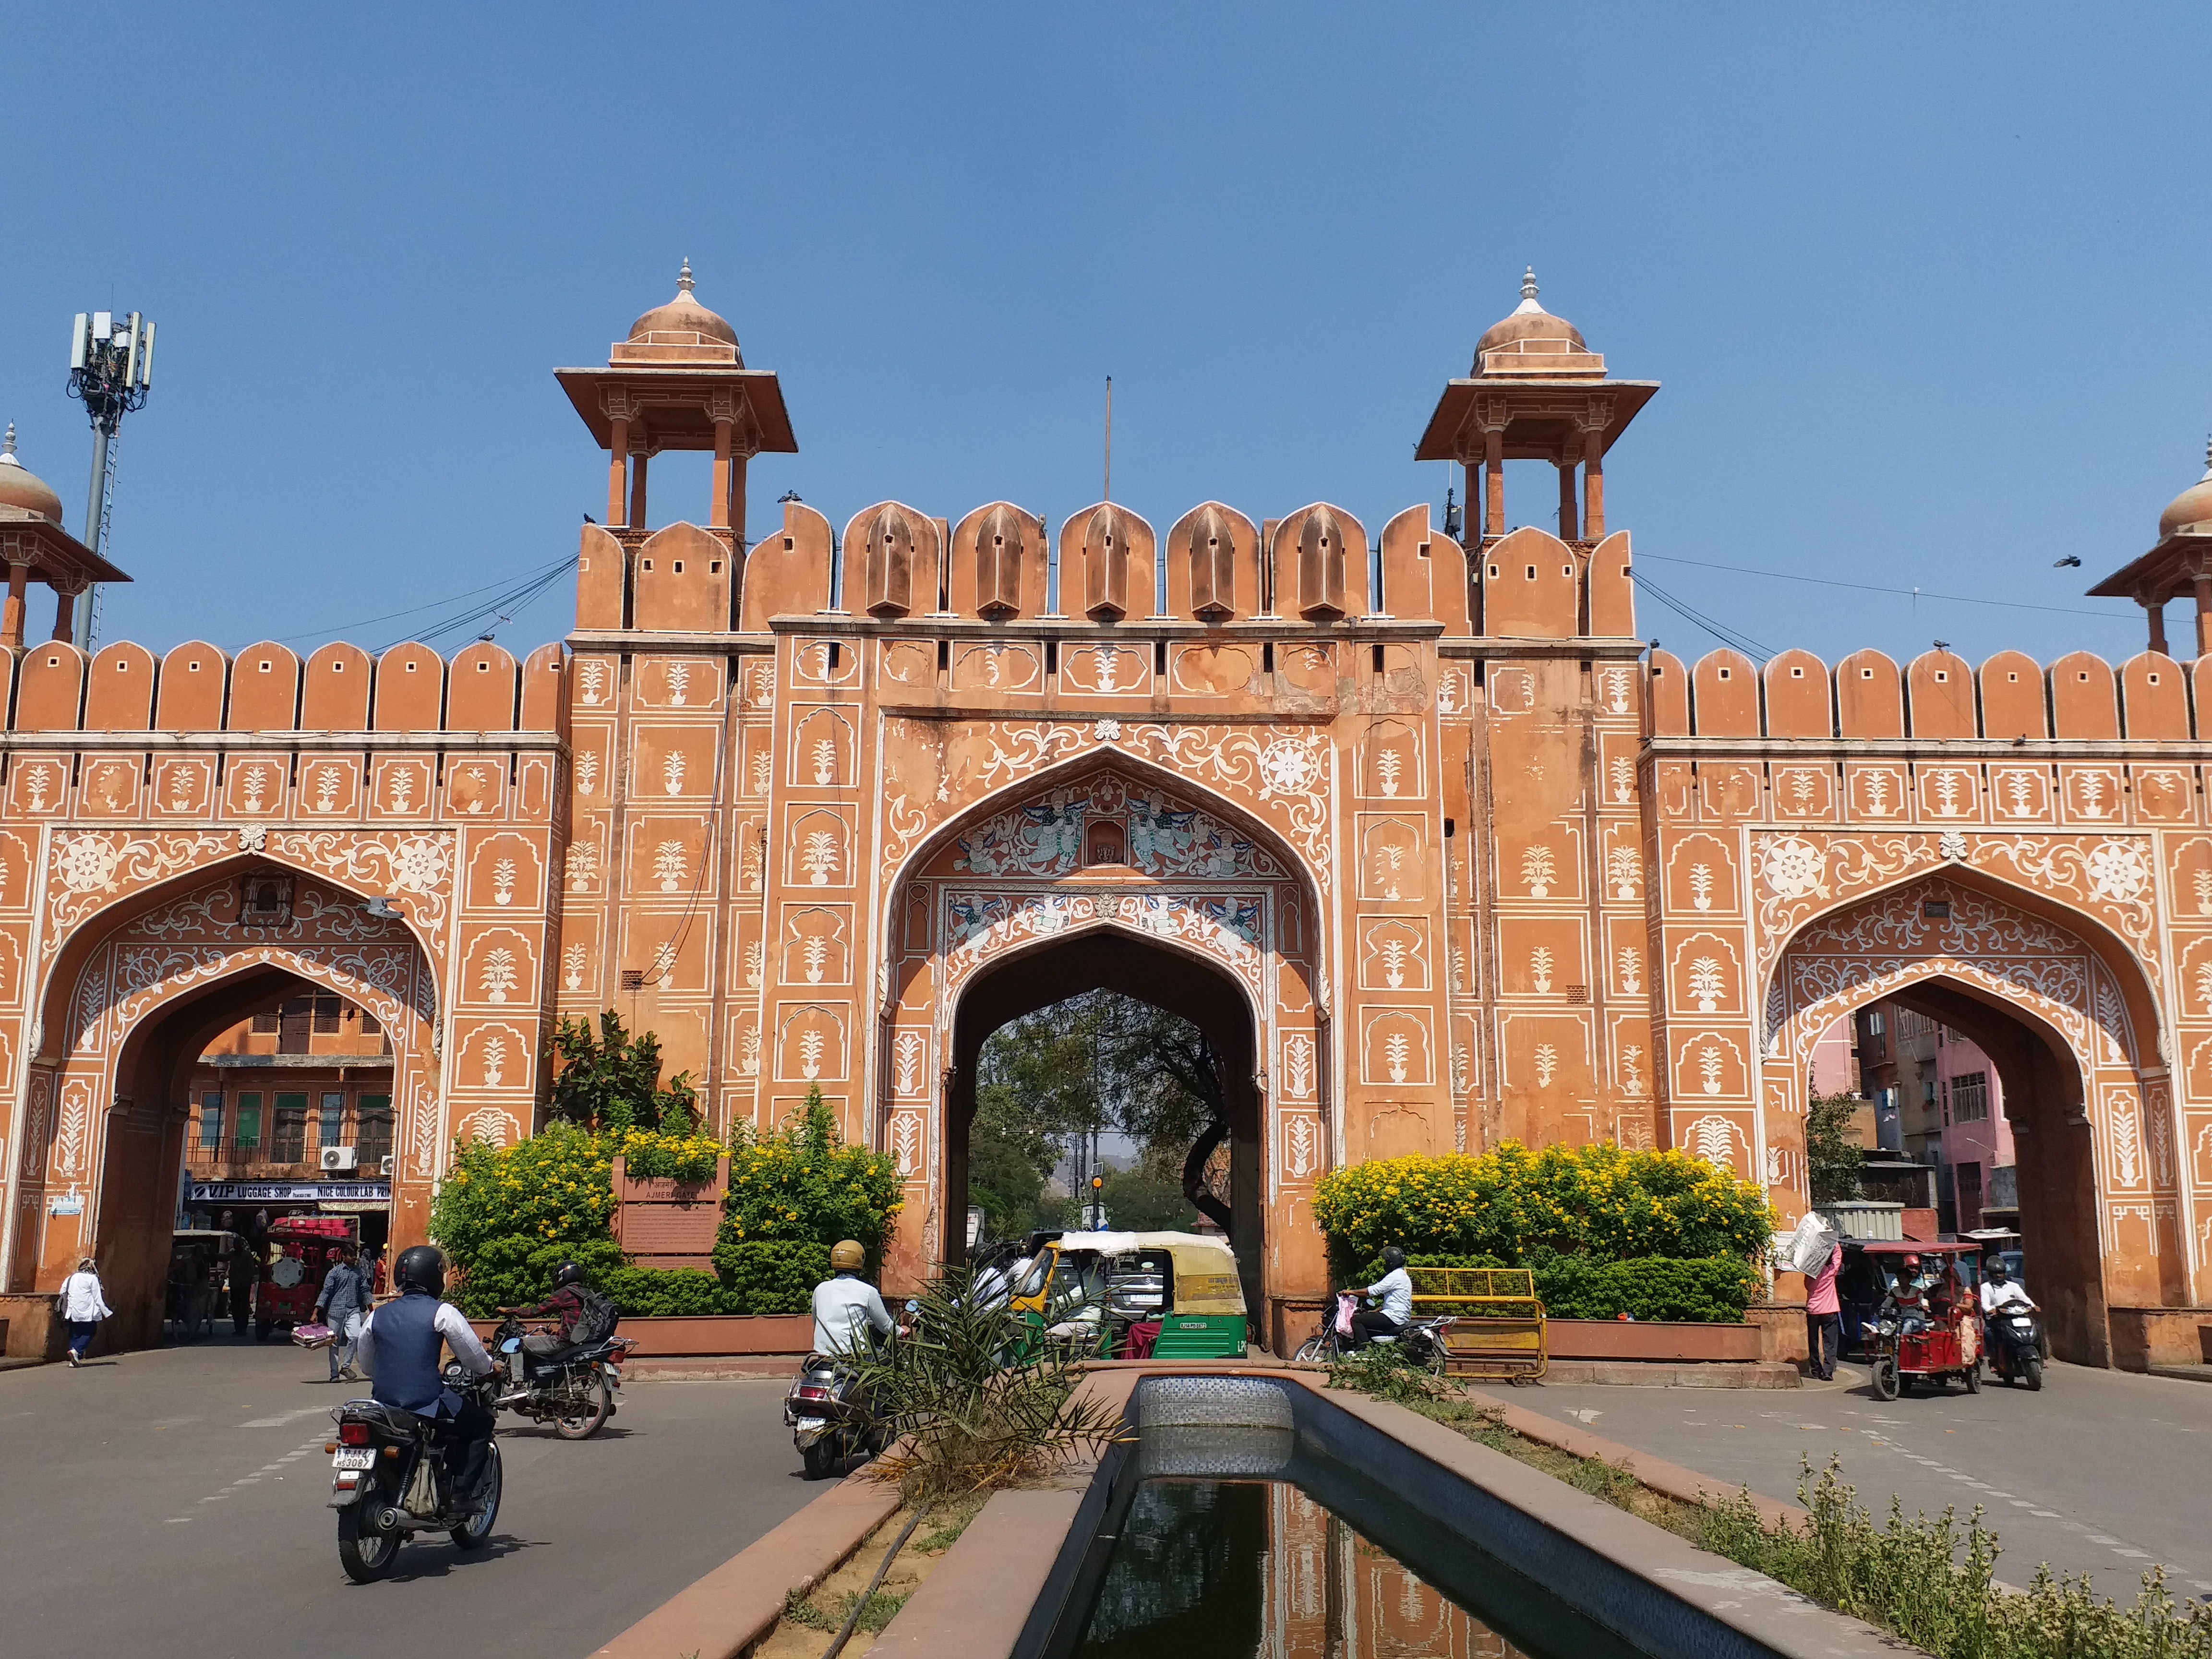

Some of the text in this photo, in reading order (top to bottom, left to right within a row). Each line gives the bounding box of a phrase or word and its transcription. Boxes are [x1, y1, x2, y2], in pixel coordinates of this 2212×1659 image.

[237, 1187, 271, 1198] LUGGAGE
[274, 1187, 291, 1198] SHOP
[317, 1186, 334, 1197] NICE
[336, 1186, 359, 1197] COLOUR
[360, 1186, 373, 1197] LAB
